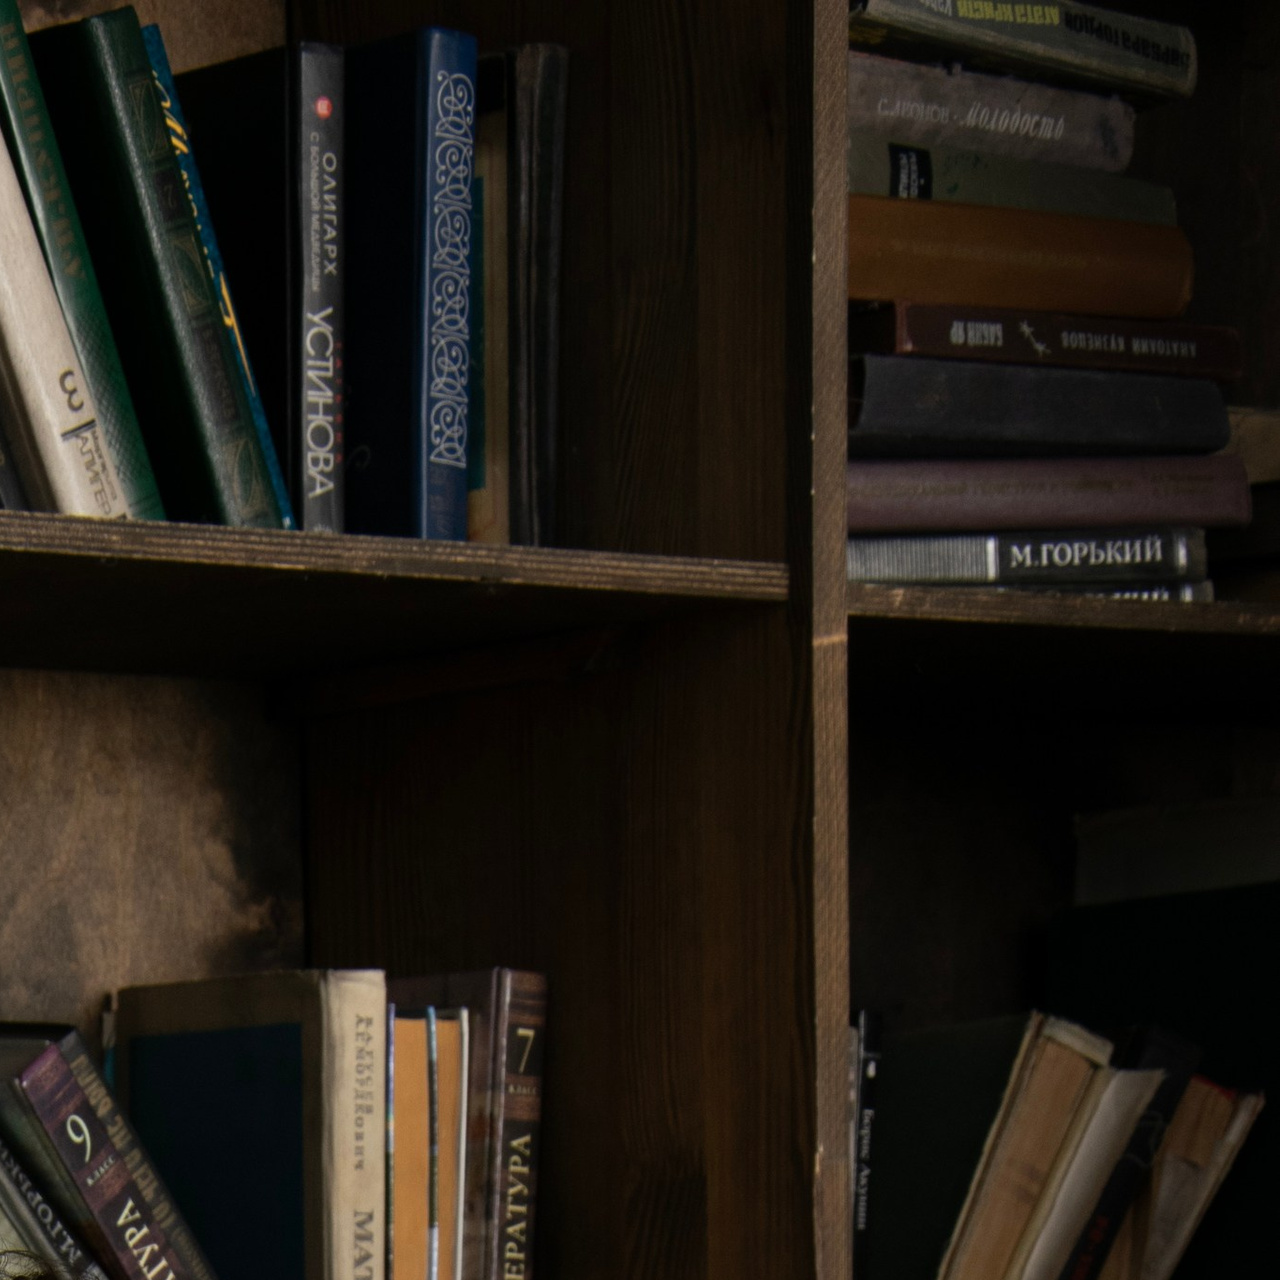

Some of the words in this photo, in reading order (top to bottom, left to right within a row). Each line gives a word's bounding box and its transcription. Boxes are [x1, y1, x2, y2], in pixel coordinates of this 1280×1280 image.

[322, 151, 338, 276] ОЛИГАРХ
[1059, 330, 1125, 353] КУЗНЕЦОВ
[1131, 335, 1196, 357] АНАТОЛИЙ
[306, 306, 335, 498] УСТИНОВА
[1009, 536, 1163, 569] М.ГОРЬКИЙ
[515, 1028, 535, 1073] 7
[66, 1113, 94, 1164] 9
